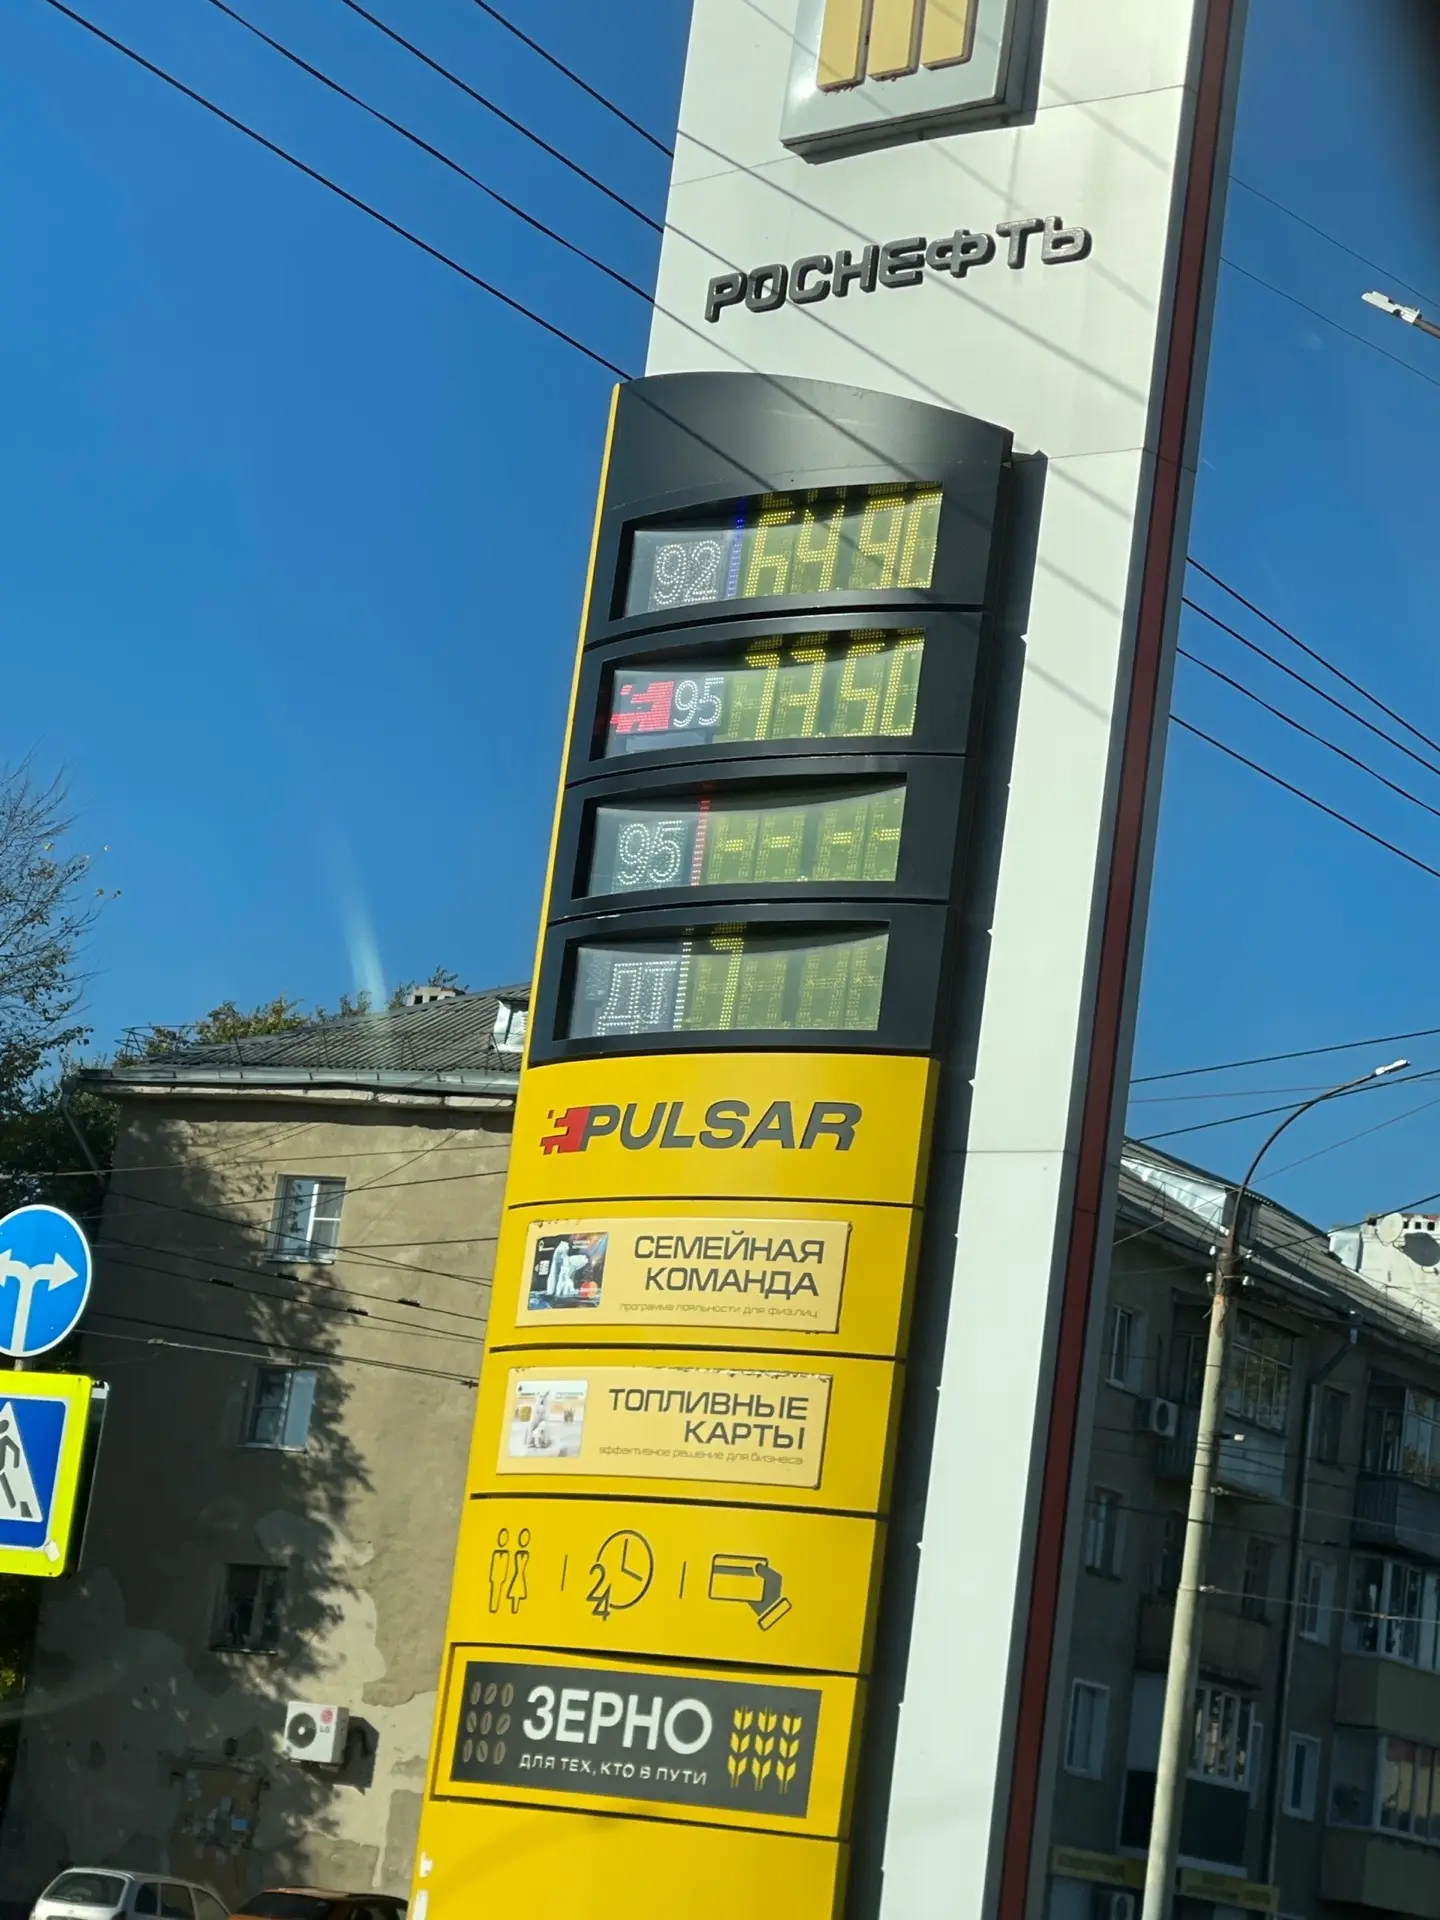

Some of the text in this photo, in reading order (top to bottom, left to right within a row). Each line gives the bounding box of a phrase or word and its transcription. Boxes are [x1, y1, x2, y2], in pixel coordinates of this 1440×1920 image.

[704, 215, 1092, 323] РОСНЕФТЬ
[654, 539, 721, 605] 92
[673, 677, 725, 728] 95
[616, 819, 685, 885] 95
[597, 960, 677, 1036] ДТ
[579, 1099, 863, 1151] PULSAR
[634, 1230, 826, 1265] СЕМЕЙНАЯ
[644, 1266, 820, 1301] КОМАНДА
[674, 1302, 741, 1314] лояльности
[743, 1305, 765, 1316] для
[608, 1387, 809, 1421] ТОПЛИВНЫЕ
[599, 1445, 804, 1466] эффективное решение для бизнеса
[683, 1420, 805, 1450] КАРТЫ
[586, 1562, 612, 1621] 24
[522, 1685, 713, 1755] ЗЕРНО
[518, 1753, 708, 1786] ДЛЯ ТЕХ, КТО В ПУТИ
